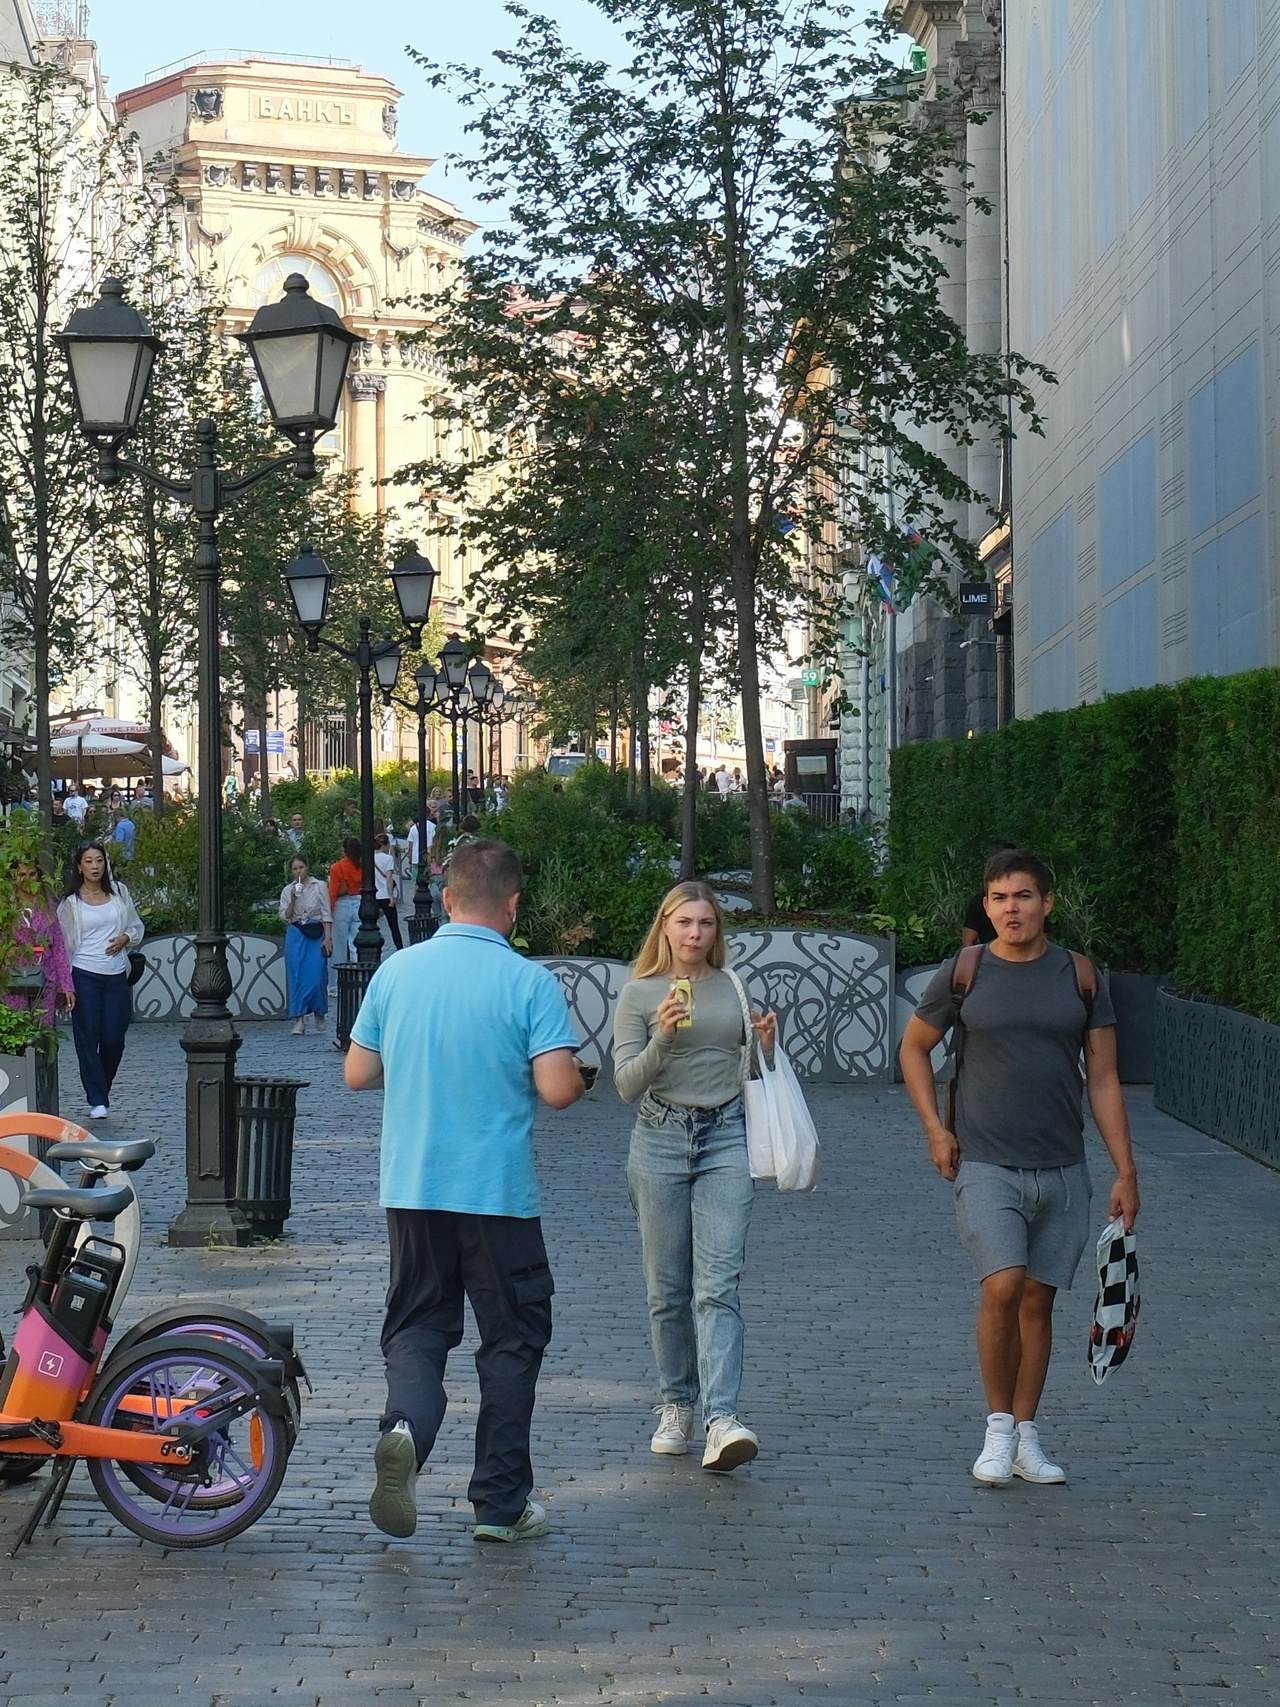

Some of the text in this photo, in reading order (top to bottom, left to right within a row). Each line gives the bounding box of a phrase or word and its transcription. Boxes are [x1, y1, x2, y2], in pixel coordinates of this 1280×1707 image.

[258, 97, 355, 125] БАНКЪ
[962, 594, 988, 603] LIME
[802, 672, 817, 682] 59
